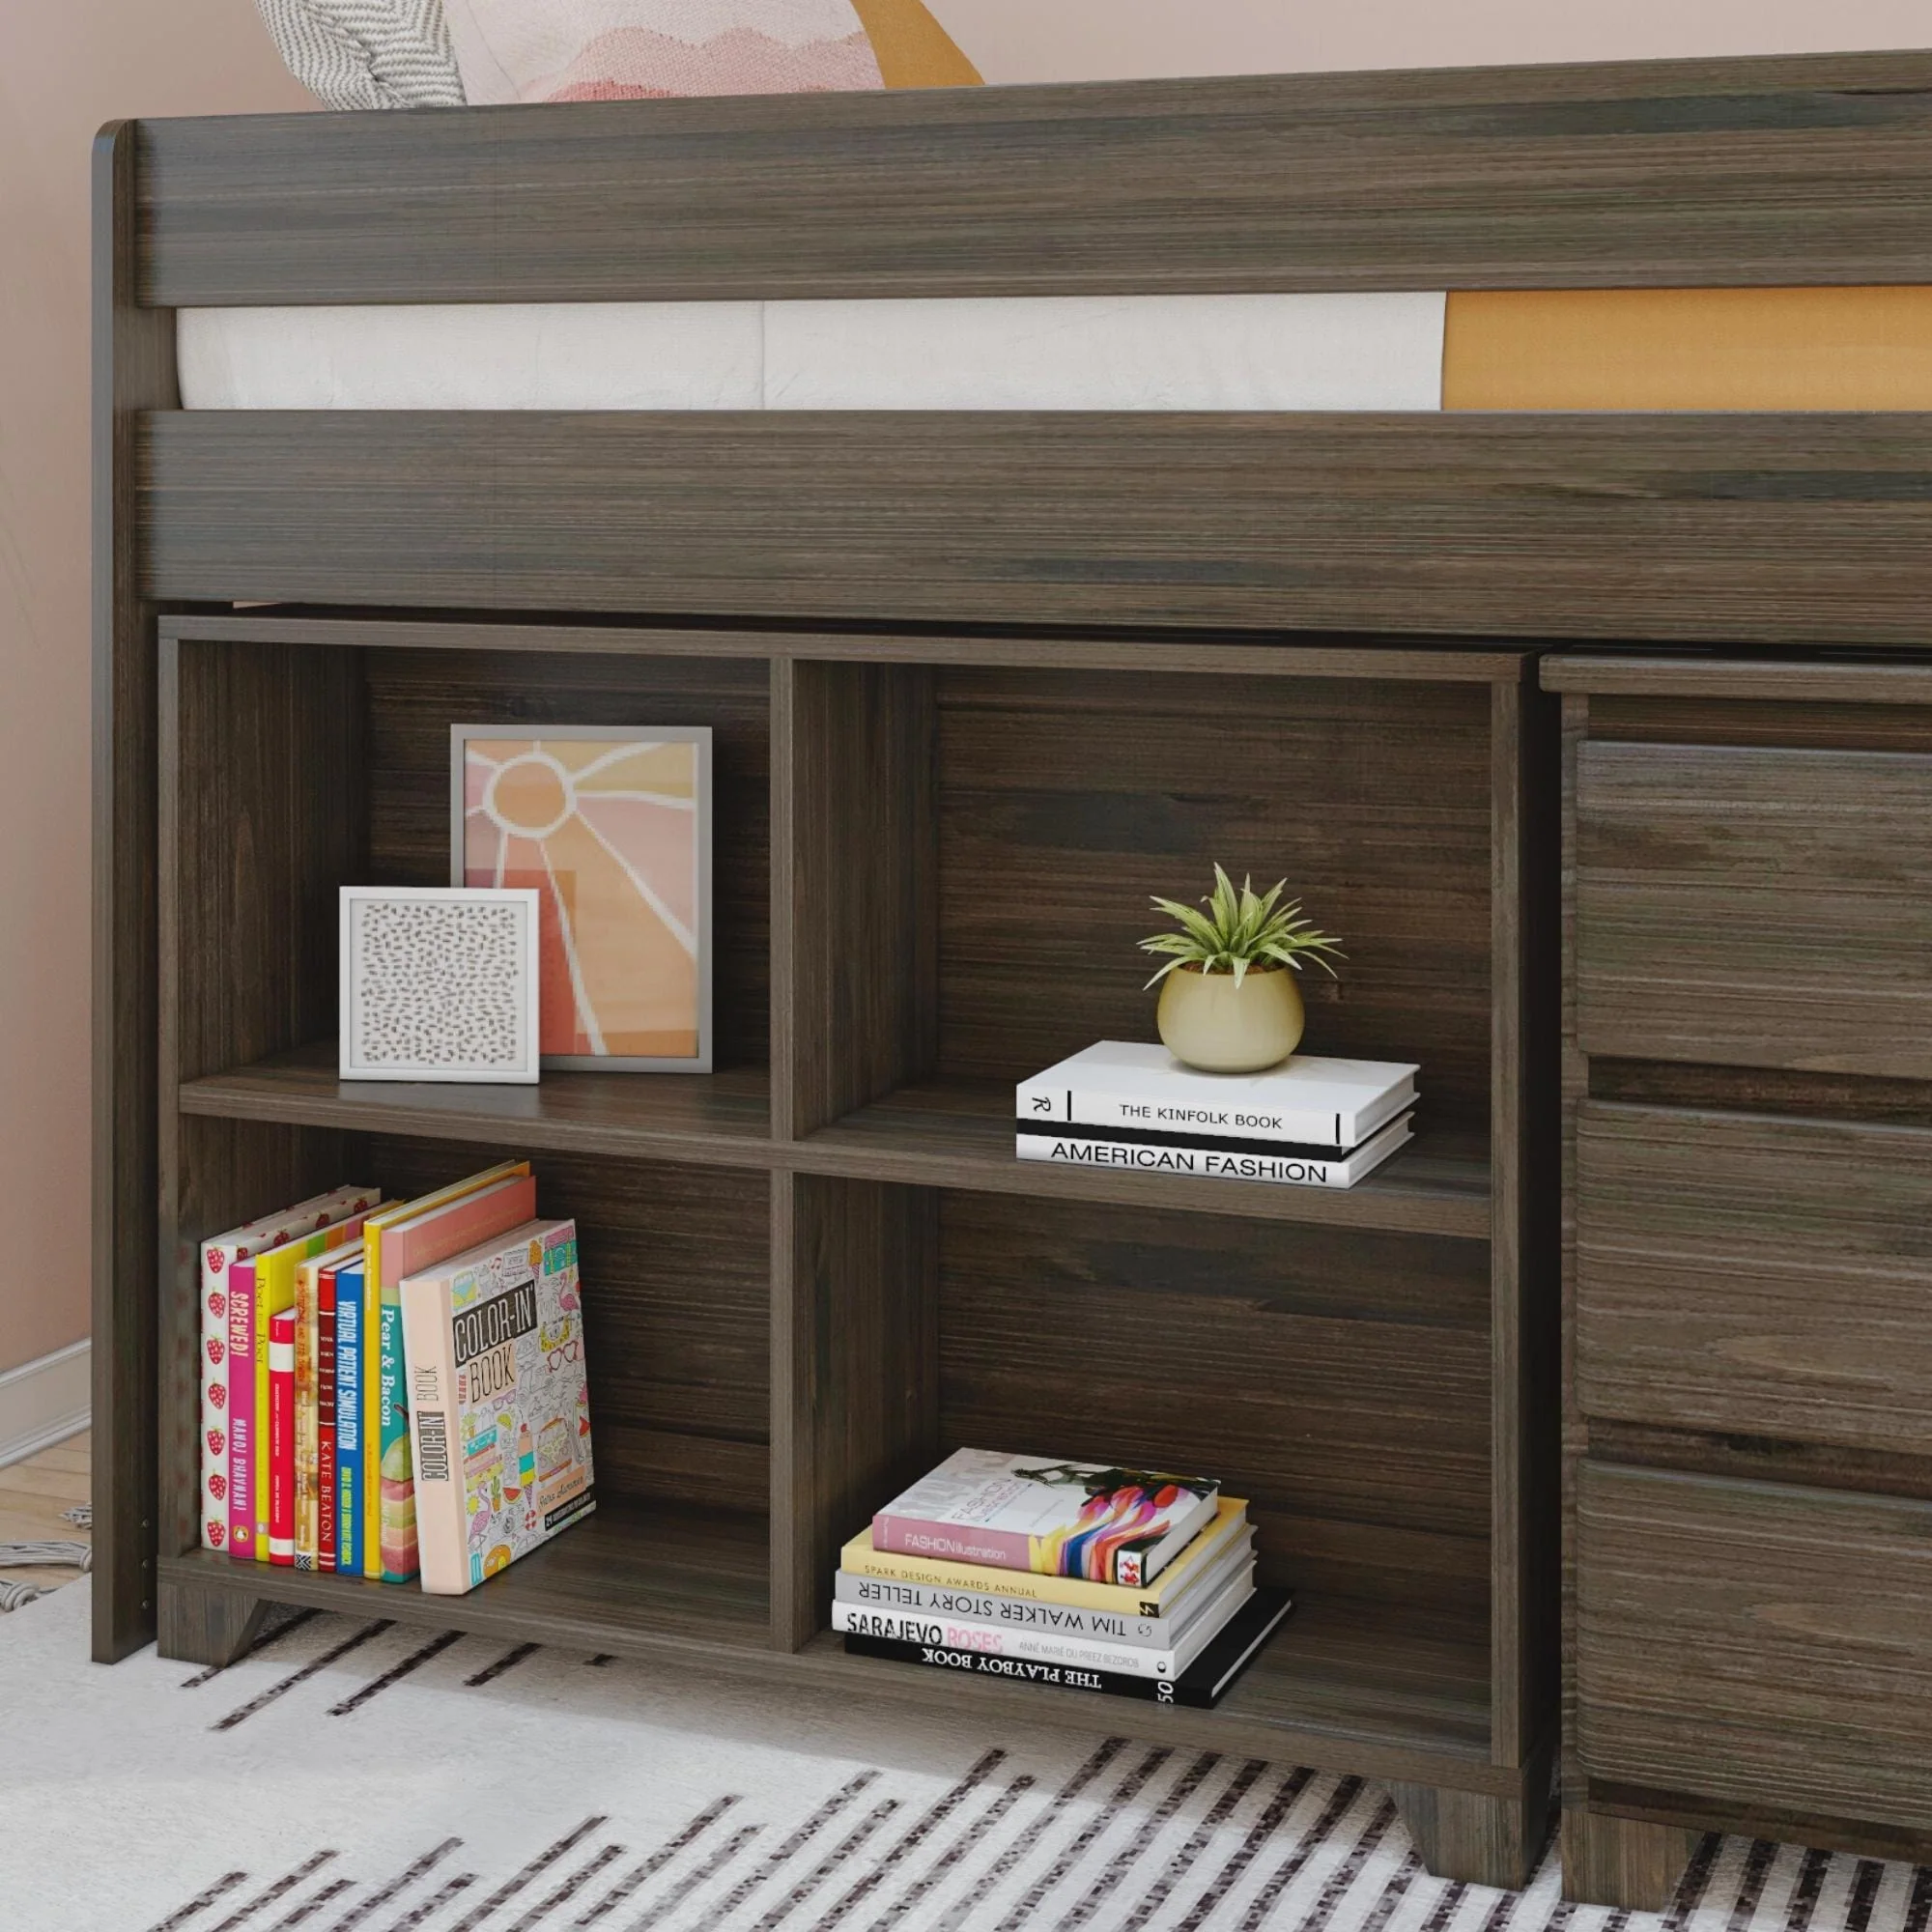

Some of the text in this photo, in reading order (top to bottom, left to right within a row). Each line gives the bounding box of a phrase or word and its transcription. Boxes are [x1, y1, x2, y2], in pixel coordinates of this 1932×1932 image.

[1119, 1104, 1284, 1130] THE KINFOLK BOOK
[1051, 1142, 1327, 1184] AMERICAN FASHION
[230, 1291, 249, 1357] SCREWED!
[337, 1300, 357, 1344] VIRTUAL
[337, 1345, 357, 1389] PATIENT
[381, 1308, 396, 1427] Pear & Bacon
[414, 1366, 439, 1402] BOOK
[469, 1343, 515, 1404] BOOK
[337, 1389, 357, 1451] SIMULATION
[232, 1418, 247, 1511] MANOJ BHAVNANI
[321, 1440, 332, 1543] KATE BEATON
[865, 1564, 1037, 1598] SPARK DESIGN AWARDS ANNUAL
[857, 1580, 1127, 1637] TIM WALKER STORY TELLER
[846, 1611, 1004, 1656] SARAJEVO ROSES
[921, 1647, 1102, 1690] THE PLAYBOY BOOK
